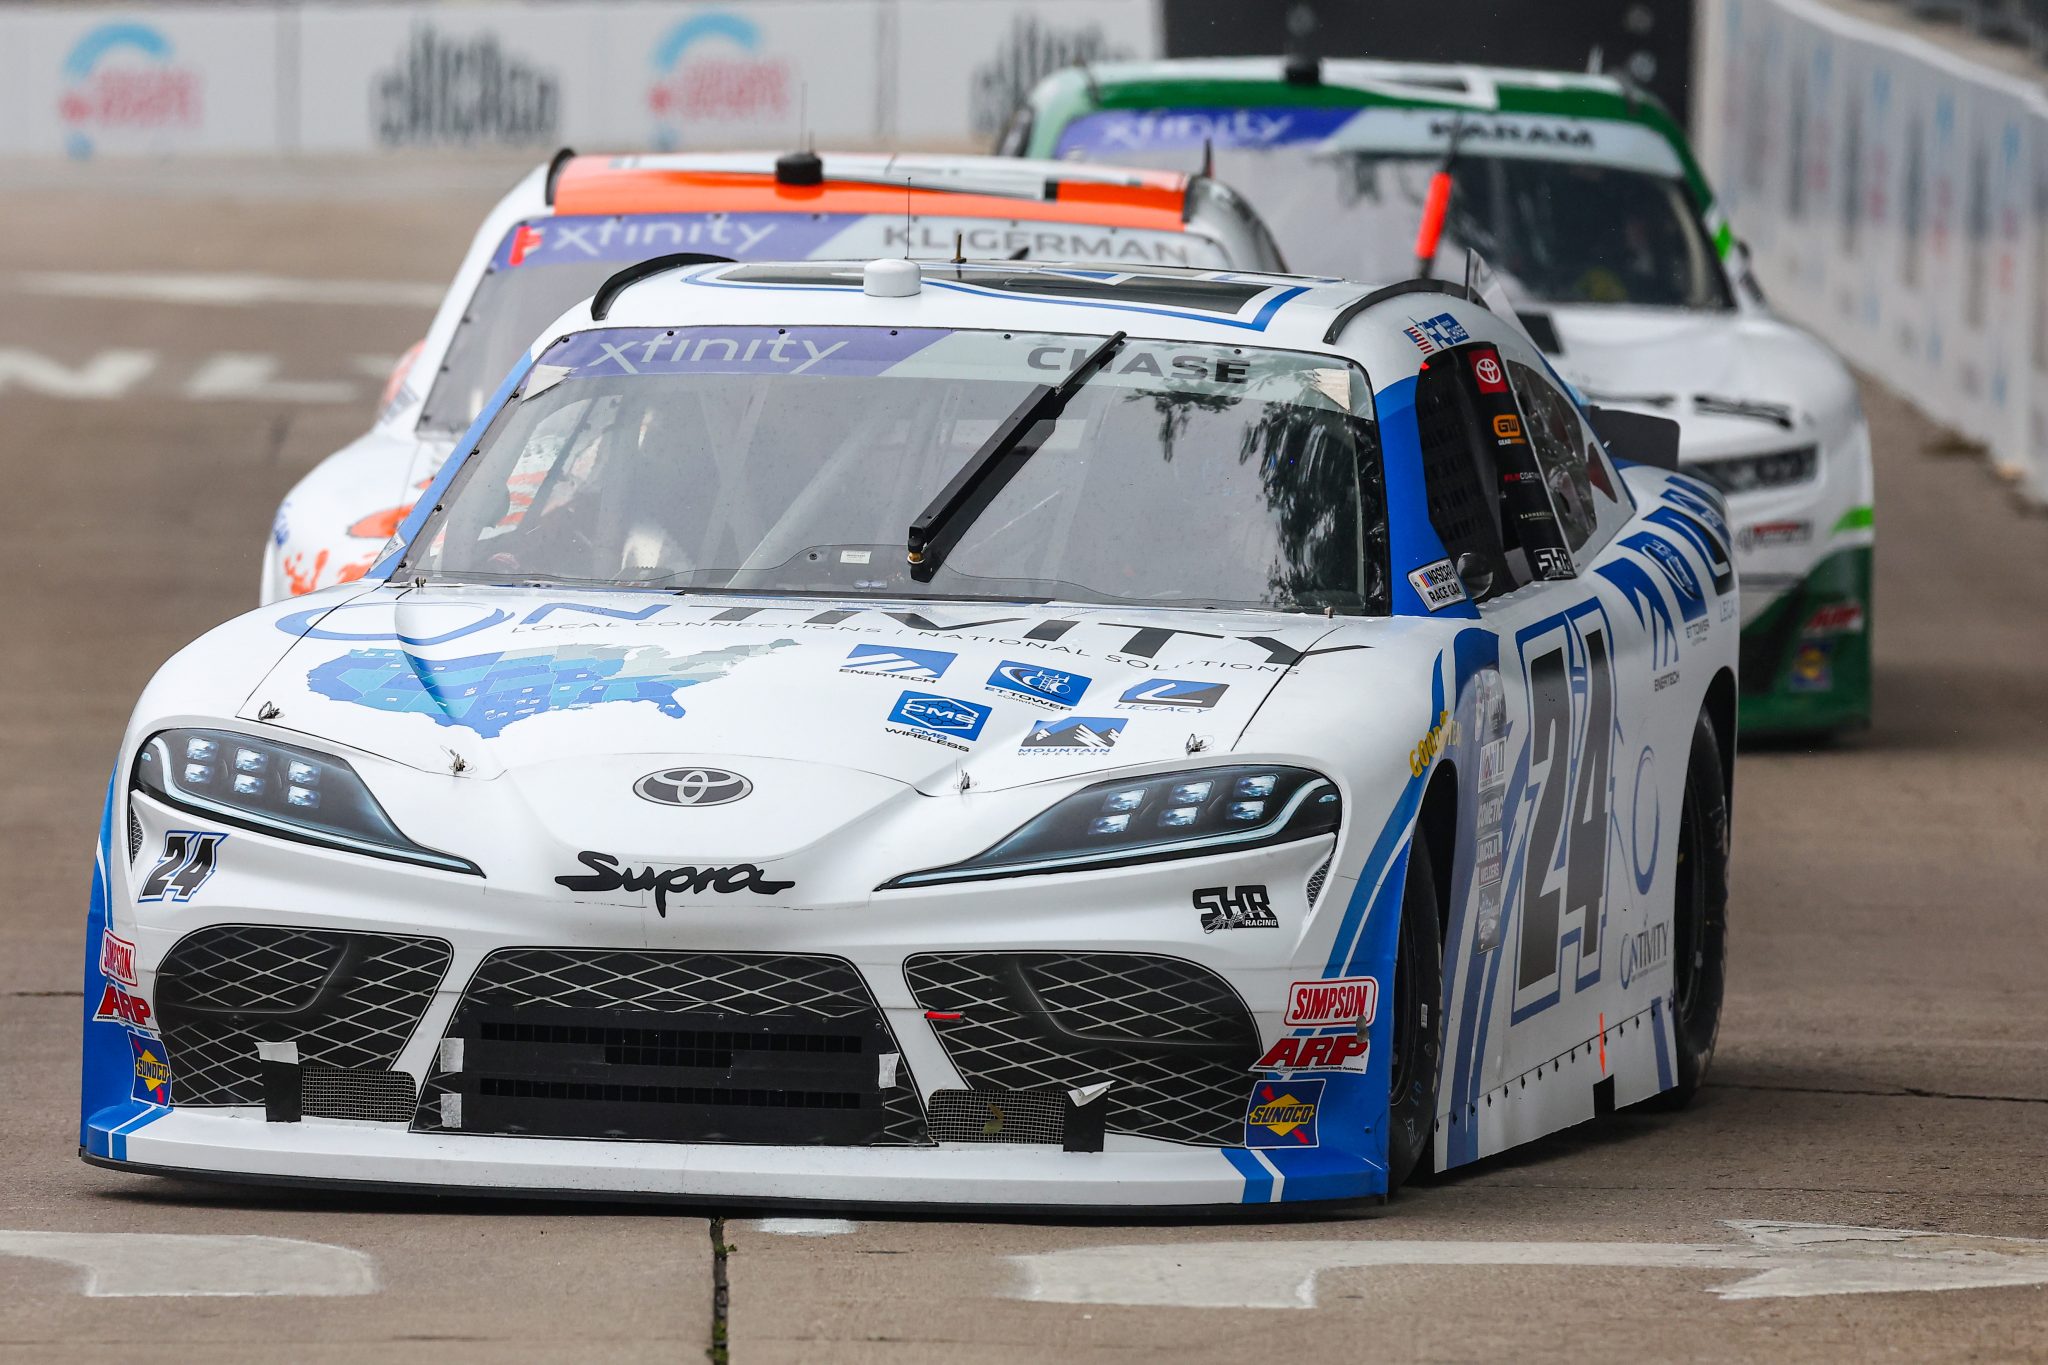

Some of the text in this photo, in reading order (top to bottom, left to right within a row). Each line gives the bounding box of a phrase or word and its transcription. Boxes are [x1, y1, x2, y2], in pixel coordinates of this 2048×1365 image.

[553, 218, 778, 256] xfinity
[883, 226, 1189, 262] KLIGERMAN
[586, 332, 850, 375] xfinity
[1428, 586, 1450, 603] RACE
[511, 622, 621, 633] LOCAL
[635, 621, 882, 634] CONNECTIONS
[918, 631, 1091, 658] NATIONAL
[838, 668, 937, 684] ENERTECH
[902, 702, 977, 725] CMS
[1008, 690, 1073, 712] TOWER
[1113, 703, 1213, 714] LEGACY
[884, 727, 970, 753] WIRELESS
[910, 727, 948, 741] CMS
[1515, 622, 1611, 1002] 24
[140, 833, 223, 900] 24
[554, 850, 796, 918] Supra
[1192, 885, 1277, 928] SHR
[1245, 919, 1277, 927] RACING
[104, 936, 133, 980] SIMPSON
[97, 984, 152, 1026] ARP
[1291, 985, 1368, 1020] SIMPSON
[1256, 1035, 1369, 1068] ARP
[137, 1059, 168, 1083] SUNOCO
[1252, 1105, 1313, 1124] SUNOCO
